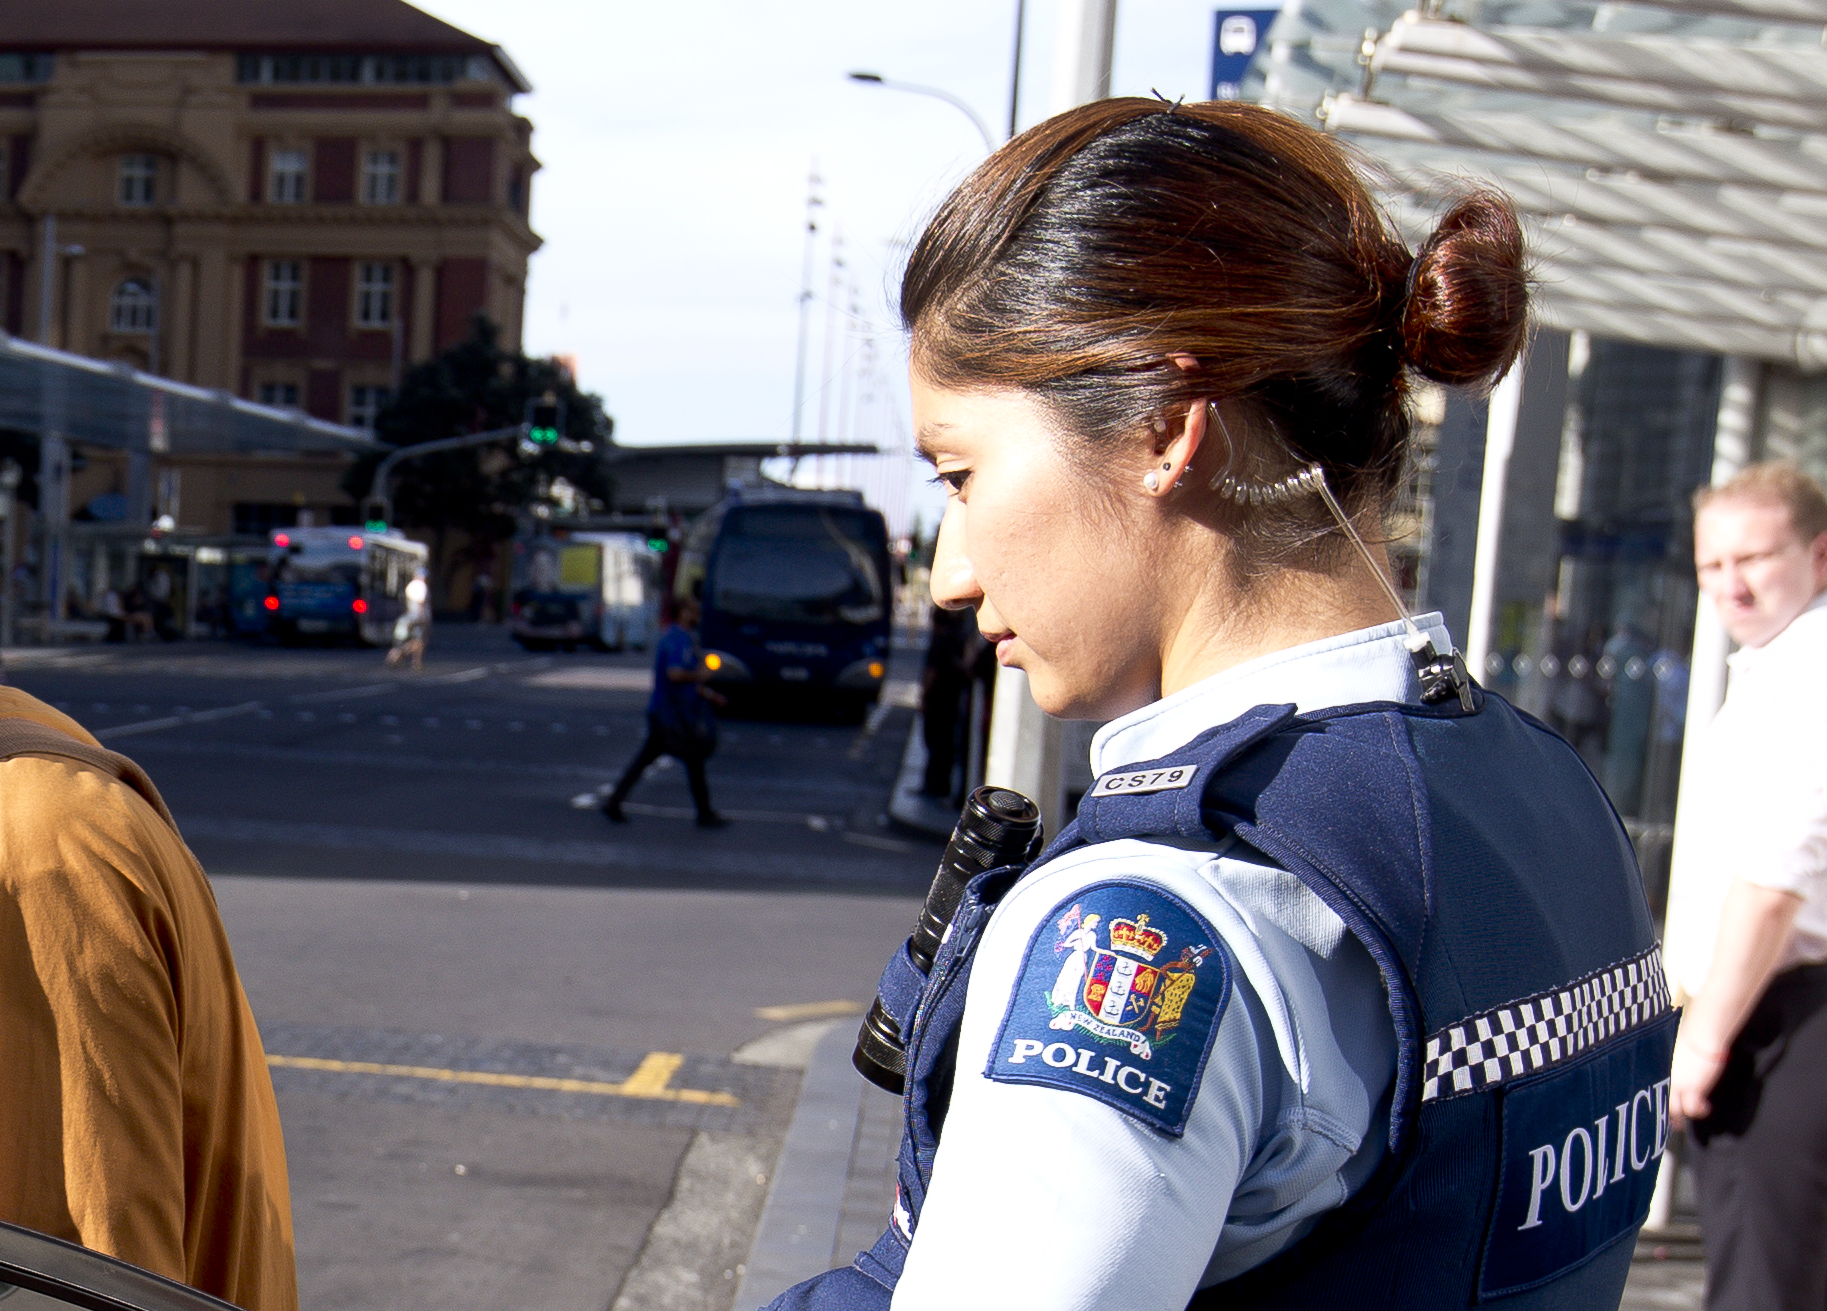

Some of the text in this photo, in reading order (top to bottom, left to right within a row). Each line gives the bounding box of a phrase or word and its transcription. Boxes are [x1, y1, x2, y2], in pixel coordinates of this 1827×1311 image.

[1105, 770, 1184, 790] CS79
[1070, 1011, 1141, 1043] NEW ZEALAND
[1008, 1039, 1171, 1110] POLICE
[1517, 1076, 1672, 1231] POLICE
